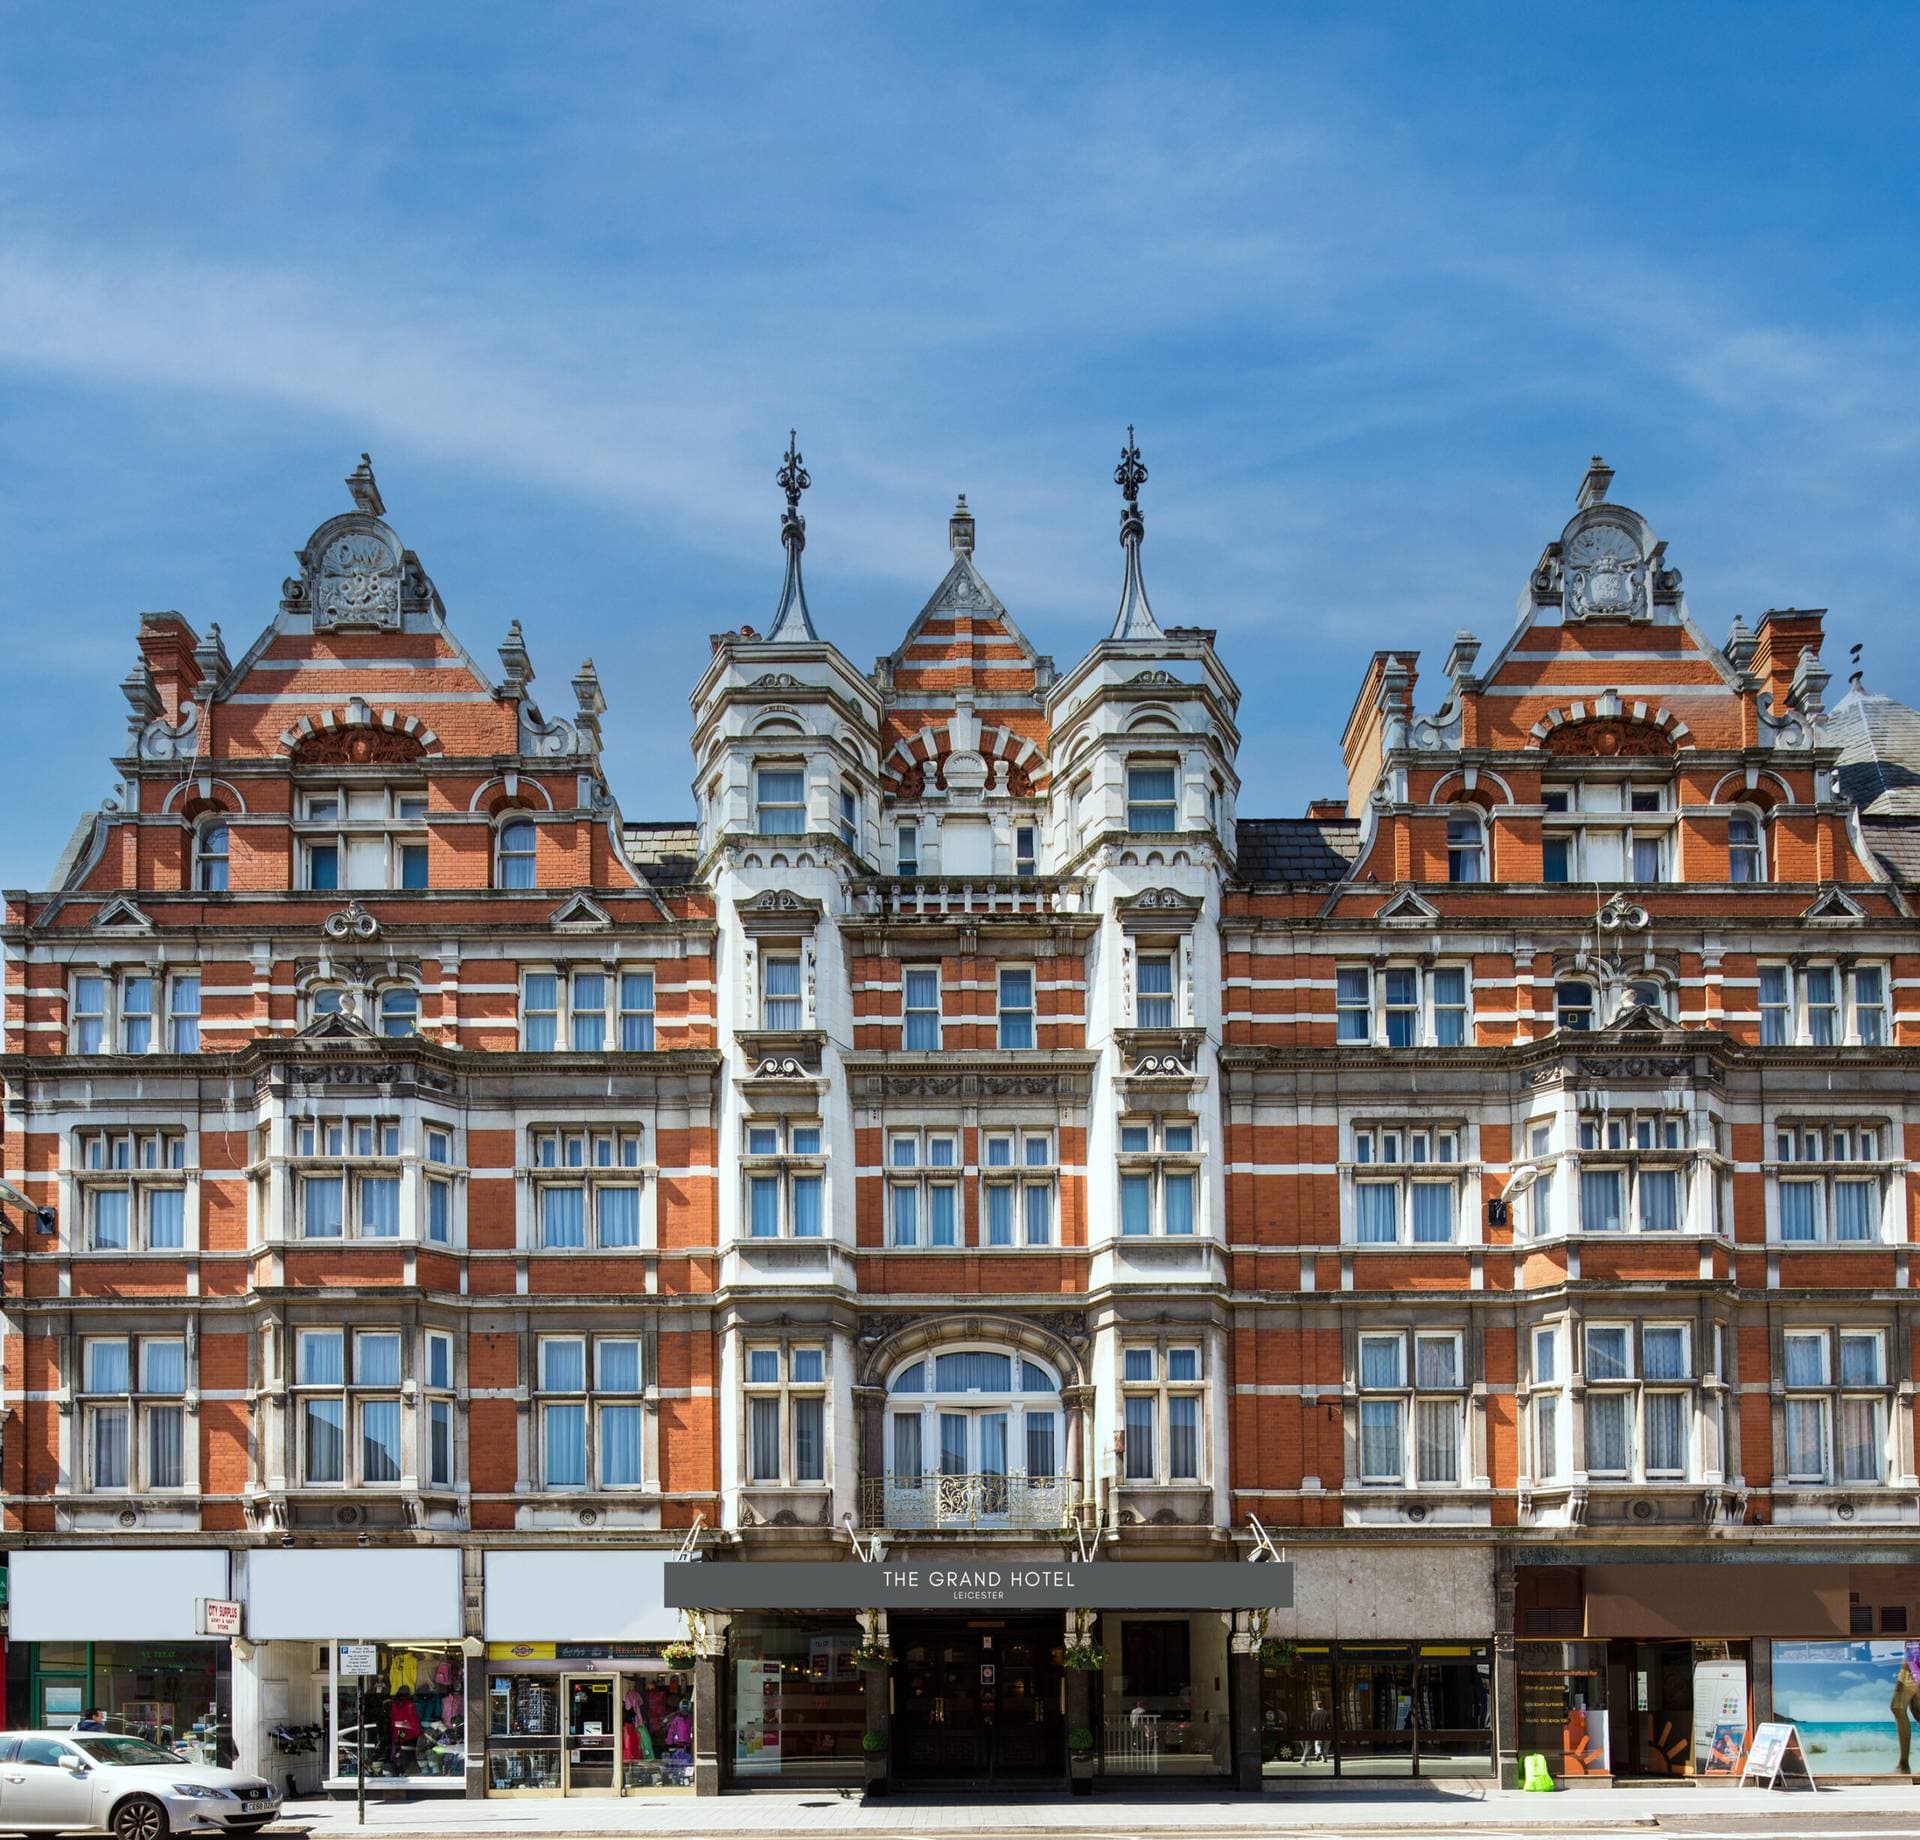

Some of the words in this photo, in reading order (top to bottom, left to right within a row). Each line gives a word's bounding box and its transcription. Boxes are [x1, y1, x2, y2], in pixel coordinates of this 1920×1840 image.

[883, 1571, 919, 1587] THE
[928, 1571, 1001, 1587] GRAND
[1011, 1571, 1075, 1587] HOTEL
[953, 1591, 1004, 1600] LEICESTER
[208, 1604, 218, 1616] CITY
[219, 1605, 238, 1618] SURPLUS
